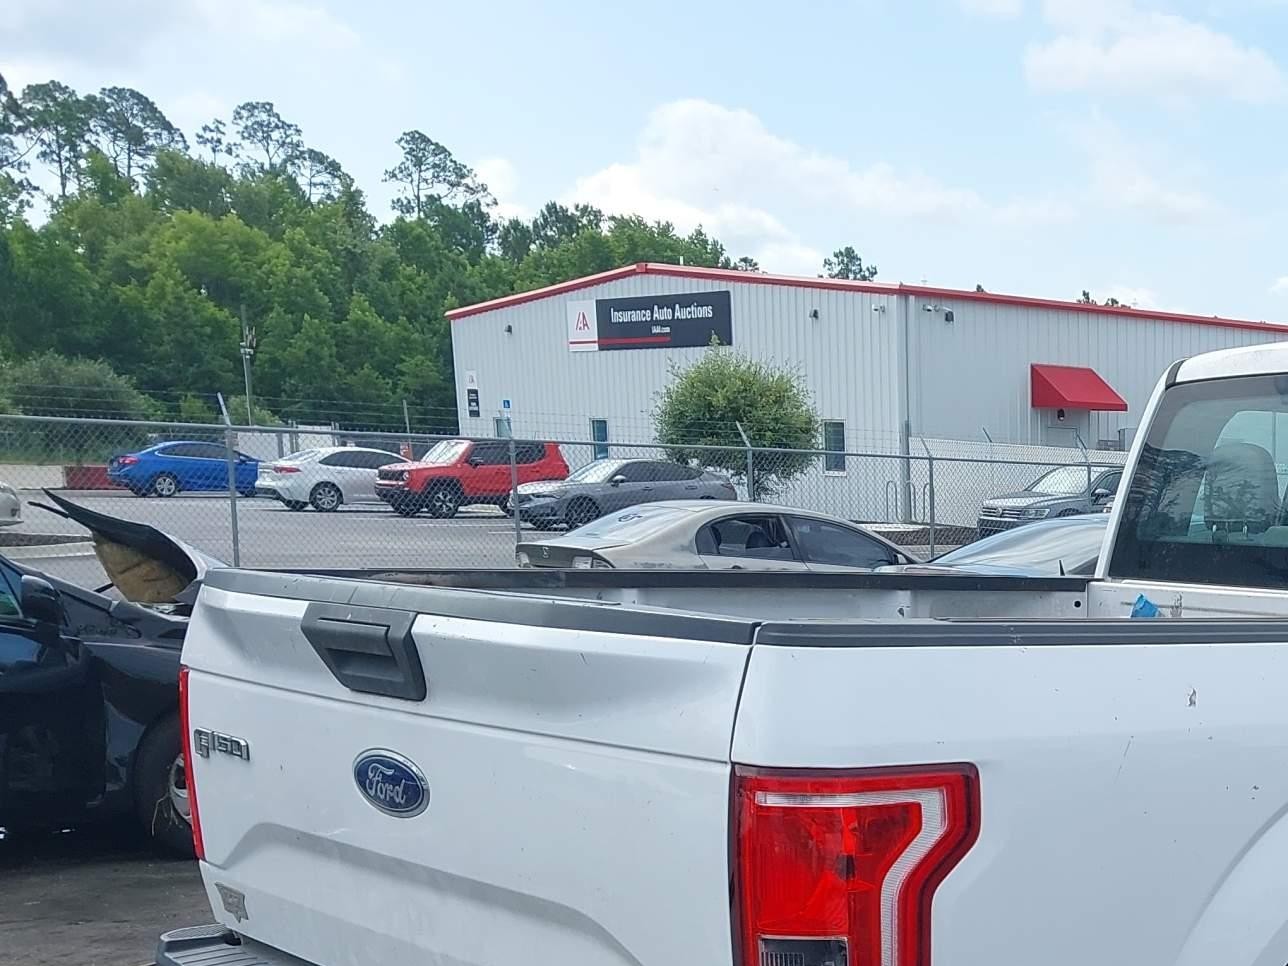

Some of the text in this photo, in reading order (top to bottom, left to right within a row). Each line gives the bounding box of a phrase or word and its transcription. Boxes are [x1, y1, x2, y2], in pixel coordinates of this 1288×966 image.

[610, 302, 713, 323] Insurance Auto Auctions
[366, 762, 407, 805] Ford
